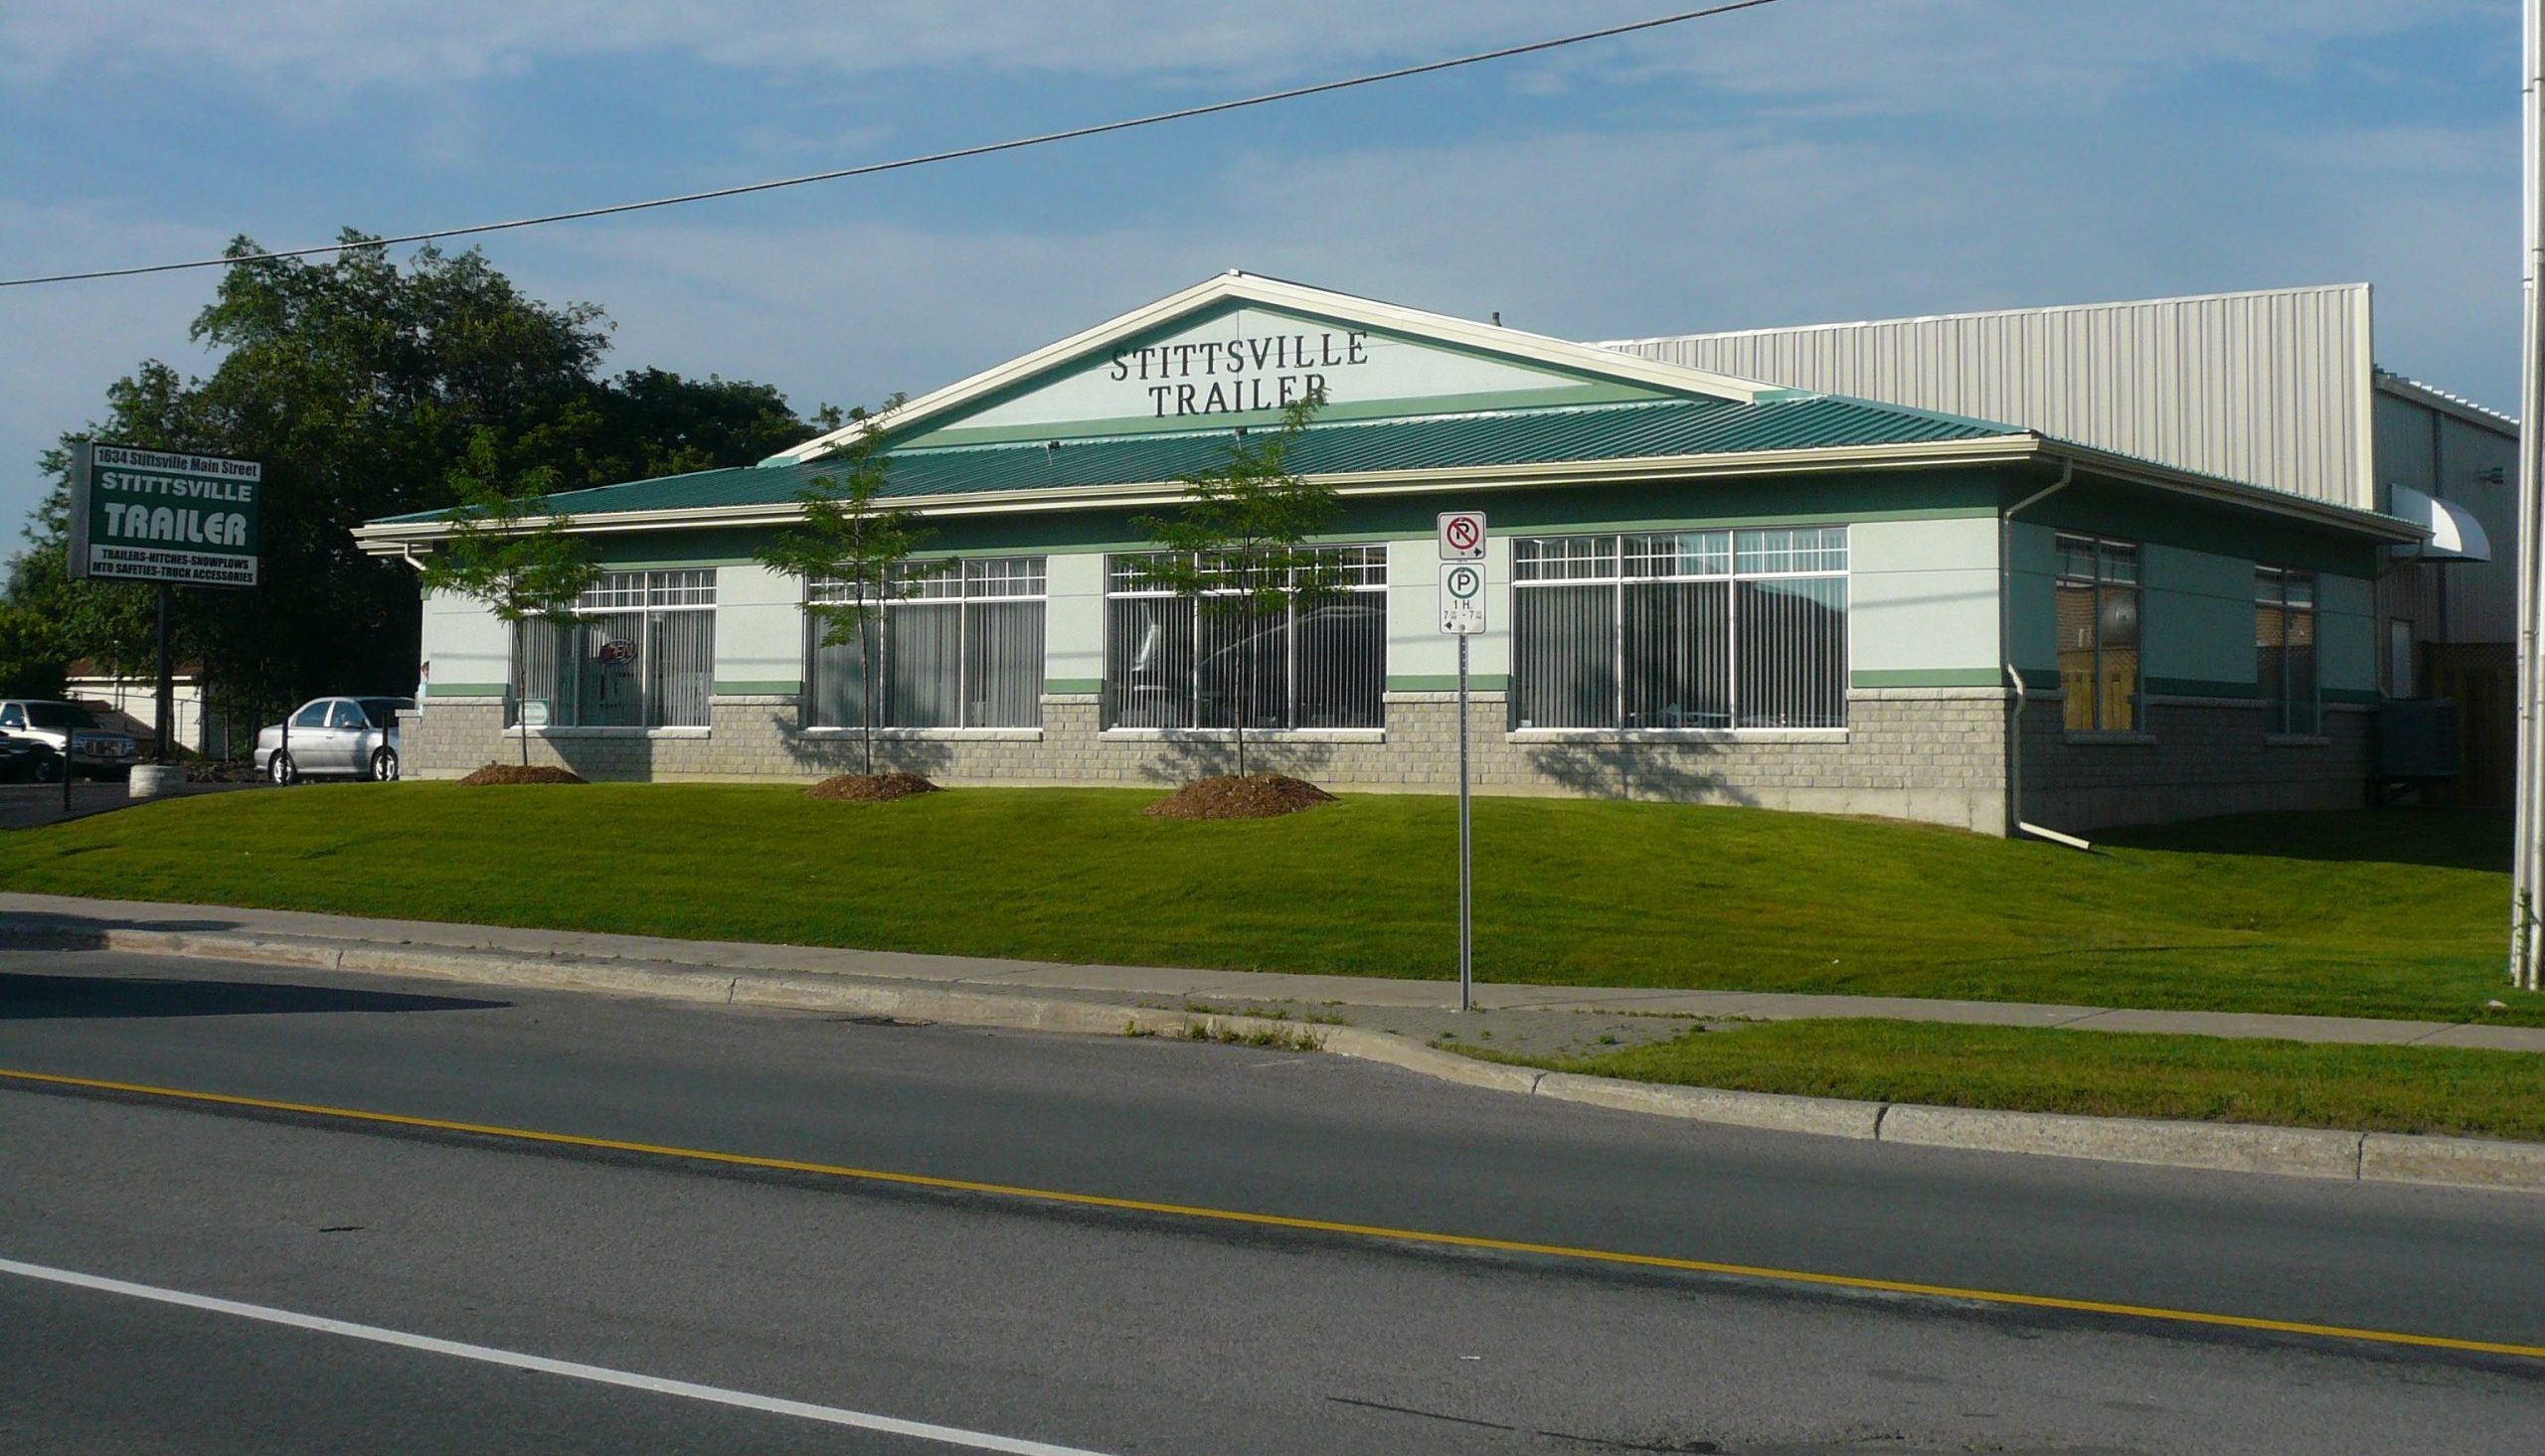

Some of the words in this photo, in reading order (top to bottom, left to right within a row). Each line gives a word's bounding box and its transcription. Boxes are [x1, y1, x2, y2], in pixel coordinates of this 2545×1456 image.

[1110, 331, 1368, 381] STITTSVILLE
[1148, 374, 1330, 417] TRAILER
[99, 449, 127, 464] 1634
[130, 453, 188, 470] Stittsville
[190, 459, 219, 472] Main
[222, 461, 257, 477] Street
[101, 471, 253, 502] STITTSVILLE
[104, 502, 248, 546] TRAILER
[1455, 523, 1470, 540] P
[193, 569, 254, 582] ACCESSORIES
[1457, 573, 1470, 590] P
